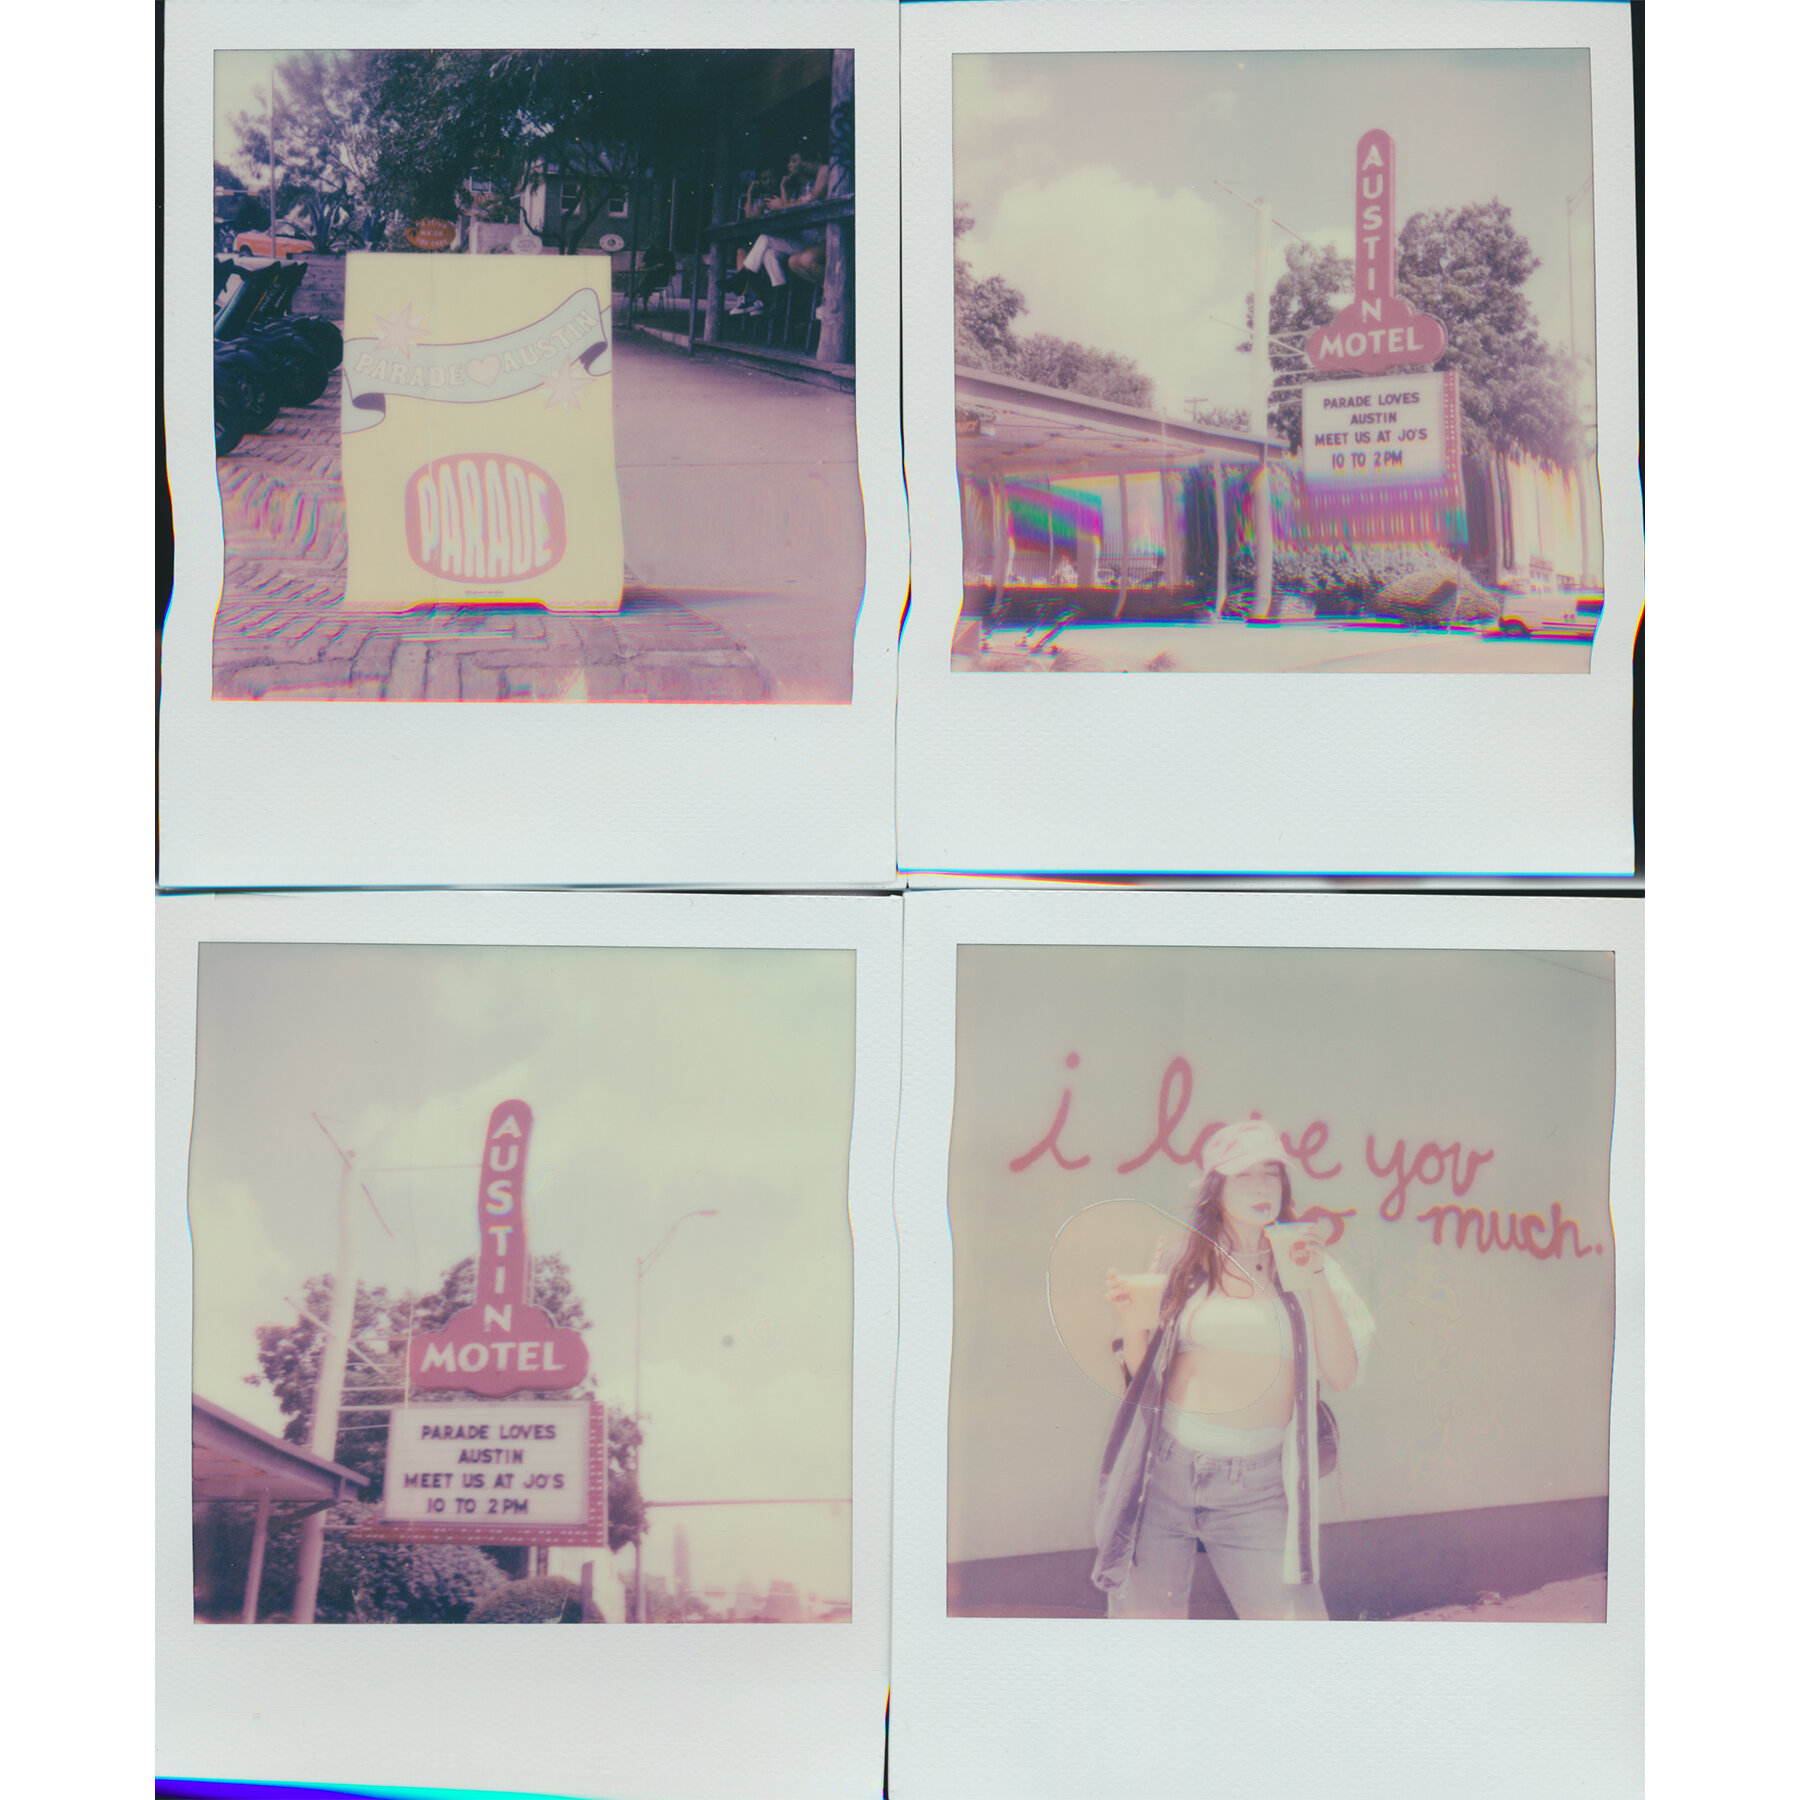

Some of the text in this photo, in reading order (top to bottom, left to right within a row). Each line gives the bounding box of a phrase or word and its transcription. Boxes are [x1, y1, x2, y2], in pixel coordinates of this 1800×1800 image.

[1361, 144, 1385, 324] AUSTIN
[353, 309, 598, 388] PARADE AUSTIN
[1319, 326, 1425, 360] MOTEL
[1323, 392, 1420, 409] PARADE LOVES
[1350, 412, 1397, 425] AUSTIN
[1315, 428, 1428, 447] MEET US AT JO'S
[1332, 453, 1345, 470] 10
[1351, 452, 1367, 469] TO
[418, 459, 552, 578] PARADE
[1009, 1051, 1091, 1173] i
[1366, 1133, 1494, 1222] you
[484, 1114, 523, 1332] AUSTIN
[420, 1342, 567, 1372] MOTEL
[422, 1425, 556, 1440] PARADE LOVES
[458, 1449, 524, 1464] AUSTIN
[404, 1473, 565, 1489] MEET US AT JO'S
[427, 1498, 445, 1513] 10
[456, 1498, 476, 1514] TO
